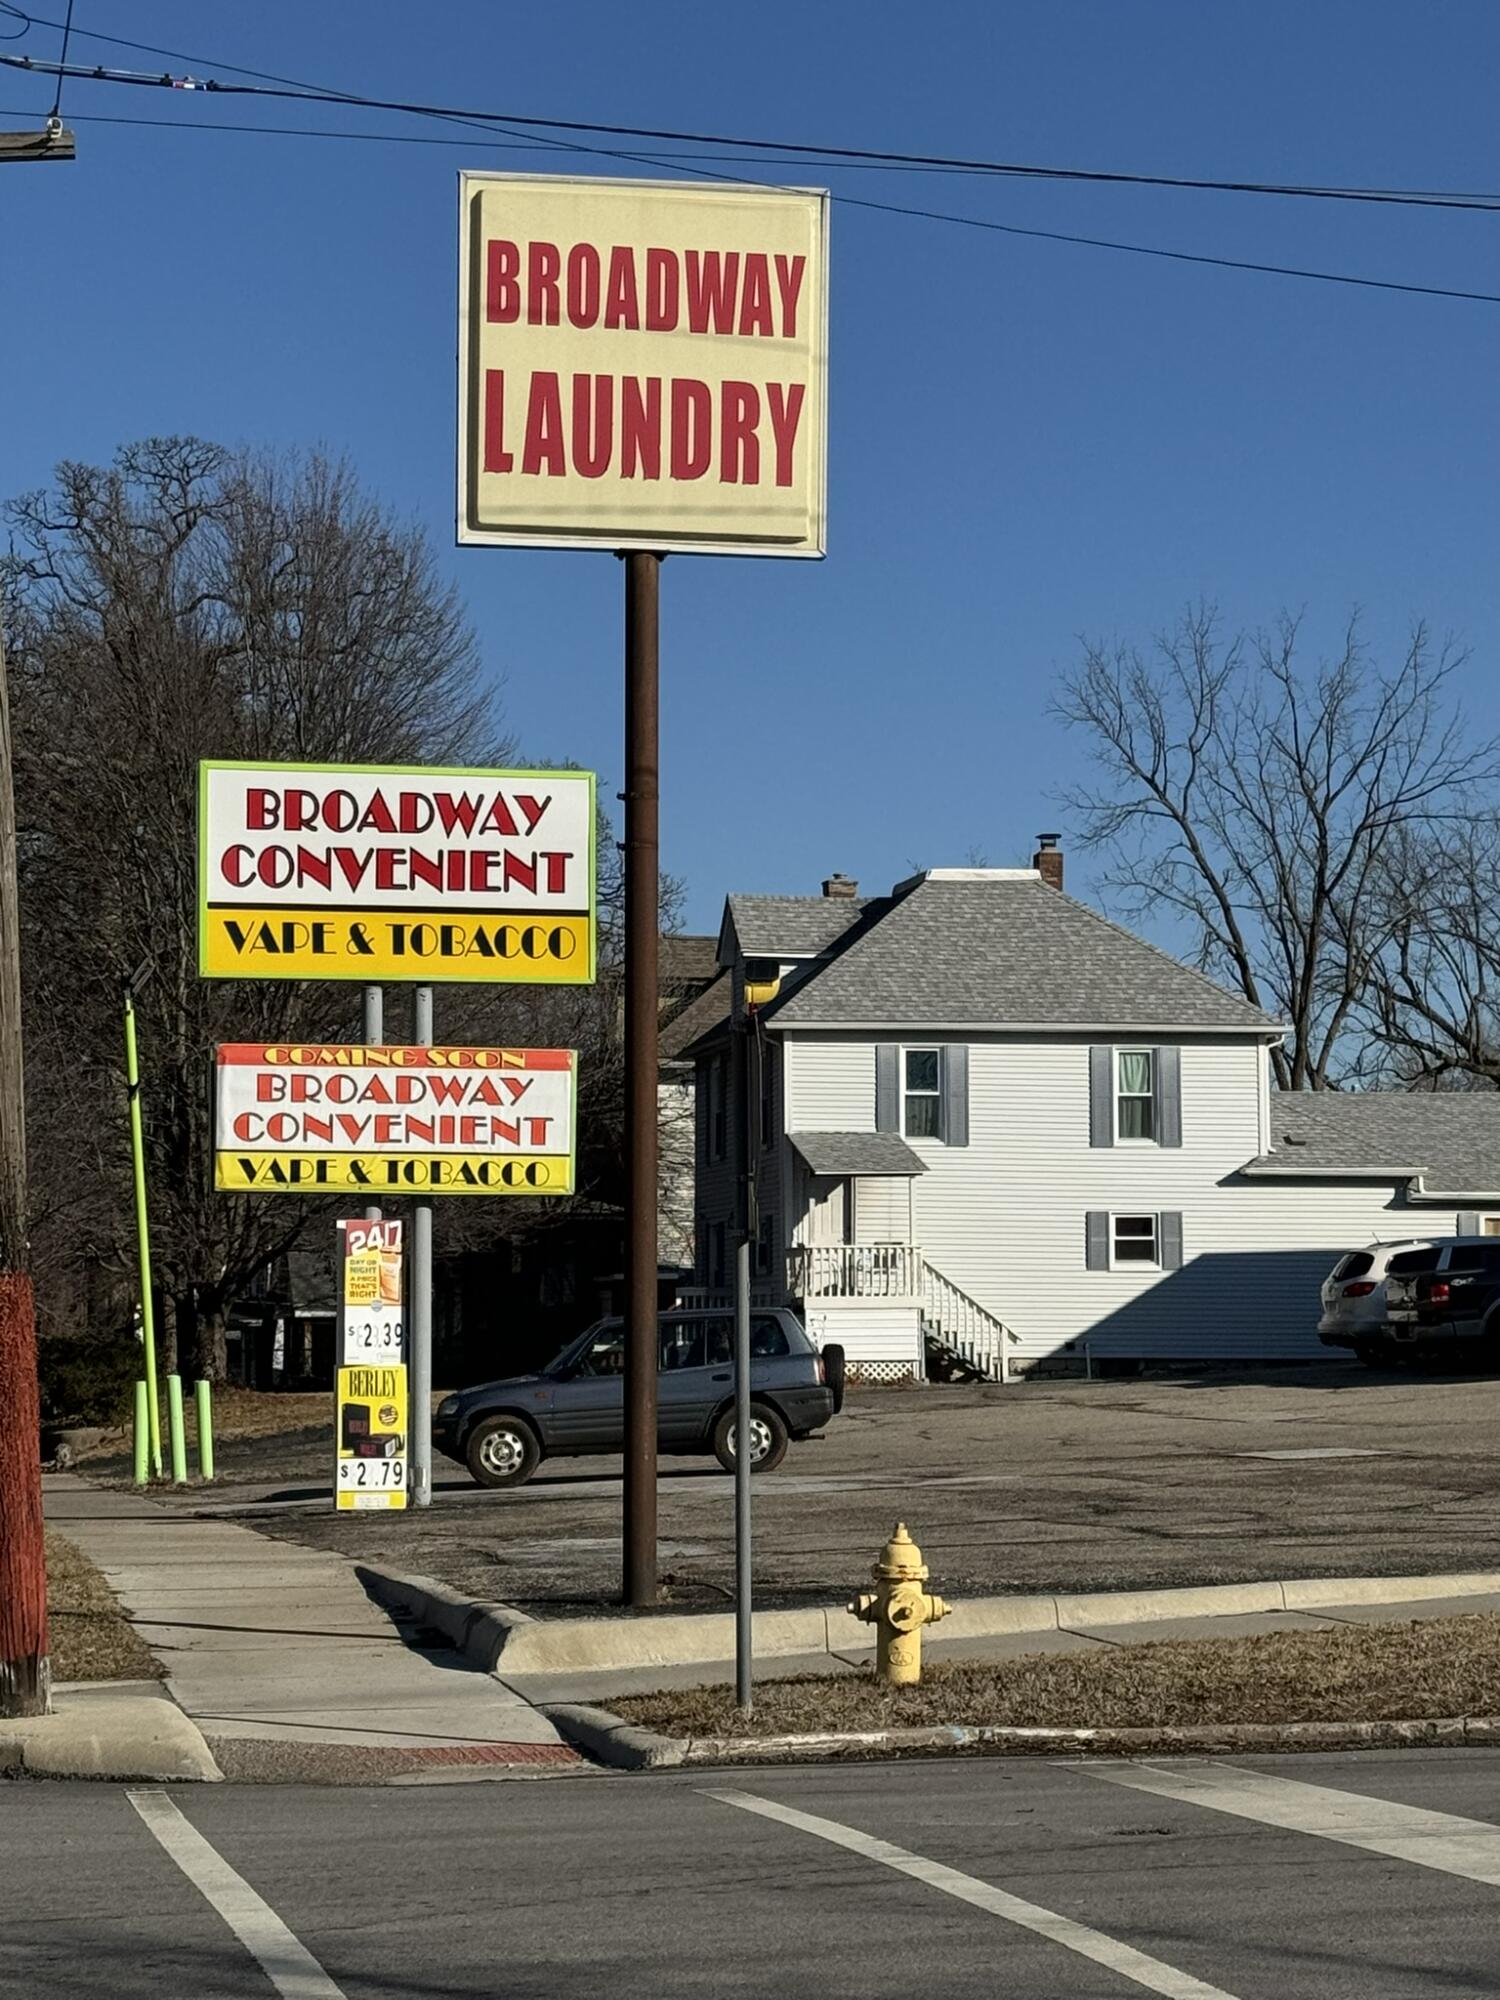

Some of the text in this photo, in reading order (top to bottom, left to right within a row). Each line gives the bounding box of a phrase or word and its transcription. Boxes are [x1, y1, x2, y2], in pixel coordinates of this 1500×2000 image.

[486, 239, 806, 338] BROADWAY
[483, 368, 806, 487] LAUNDRY
[246, 787, 552, 839] BROADWAY
[220, 844, 574, 896] CONVENIENT
[223, 920, 576, 960] VAPE & TOBACCO
[263, 1047, 526, 1070] COMING SOON
[257, 1073, 534, 1106] BROADWAY
[233, 1112, 554, 1146] CONVENIENT
[237, 1158, 550, 1187] VAPE & TOBACCO
[349, 1370, 399, 1397] BERLEY
